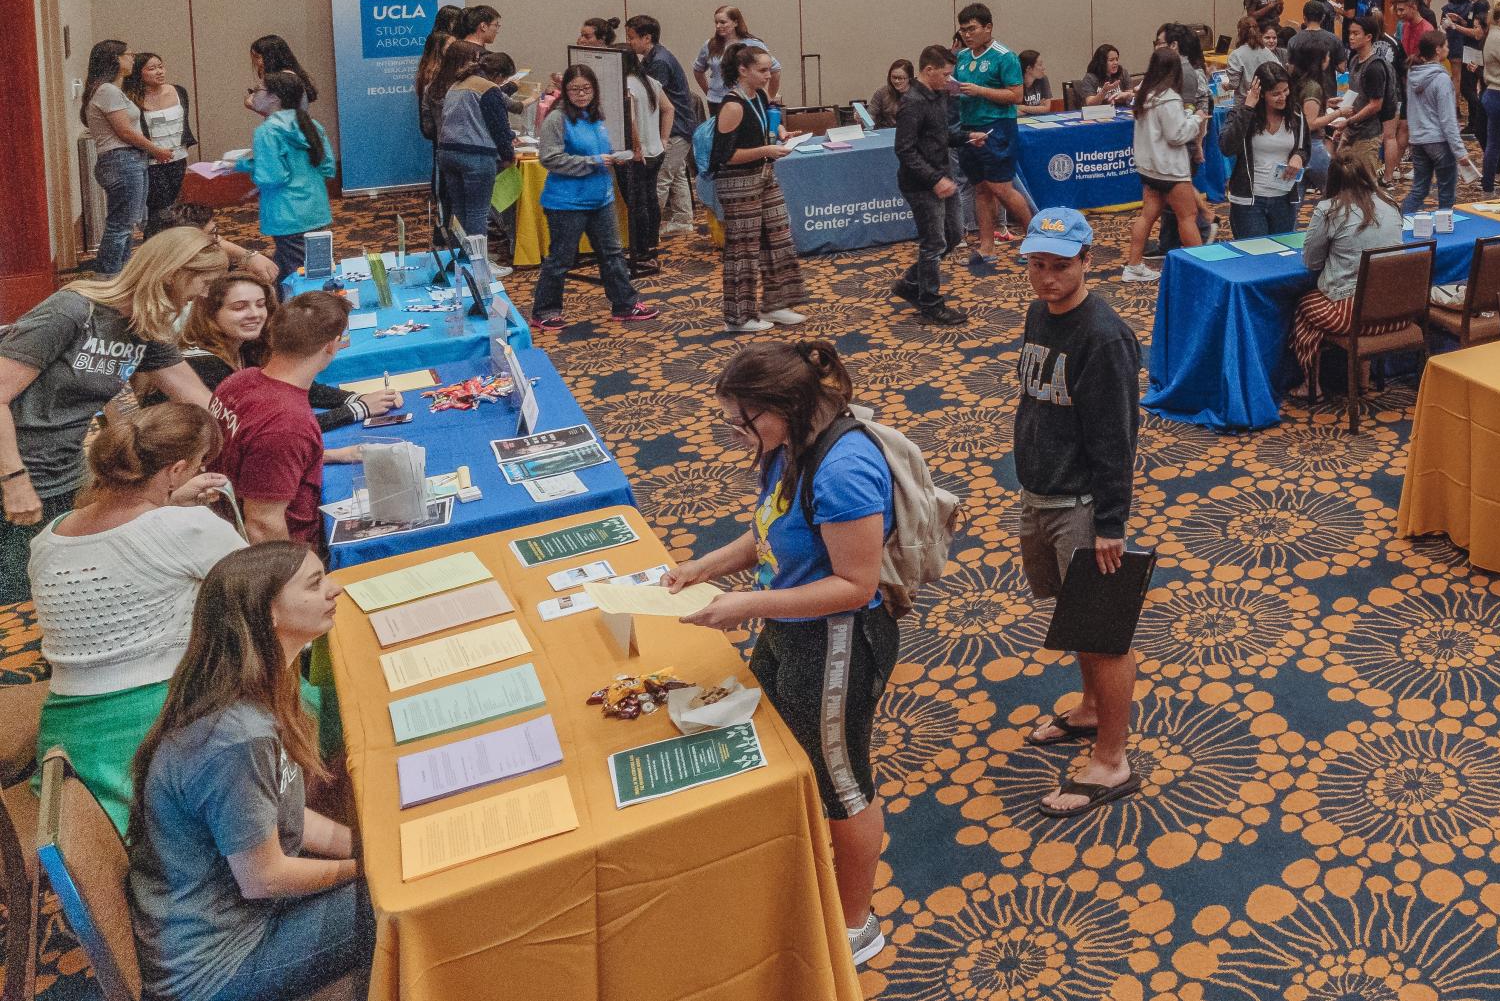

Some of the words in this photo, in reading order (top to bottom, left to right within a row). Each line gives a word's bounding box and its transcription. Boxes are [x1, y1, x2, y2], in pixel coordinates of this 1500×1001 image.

[373, 3, 426, 20] UCLA
[376, 25, 414, 36] STUDY
[376, 36, 427, 48] ABROAD
[1075, 160, 1126, 173] Research
[804, 197, 904, 217] Undergraduate
[804, 218, 851, 231] Center
[862, 210, 914, 224] Science
[82, 336, 134, 358] MAJOR
[72, 352, 134, 377] BLAST
[832, 624, 849, 656] PINK
[828, 660, 845, 690] PINK
